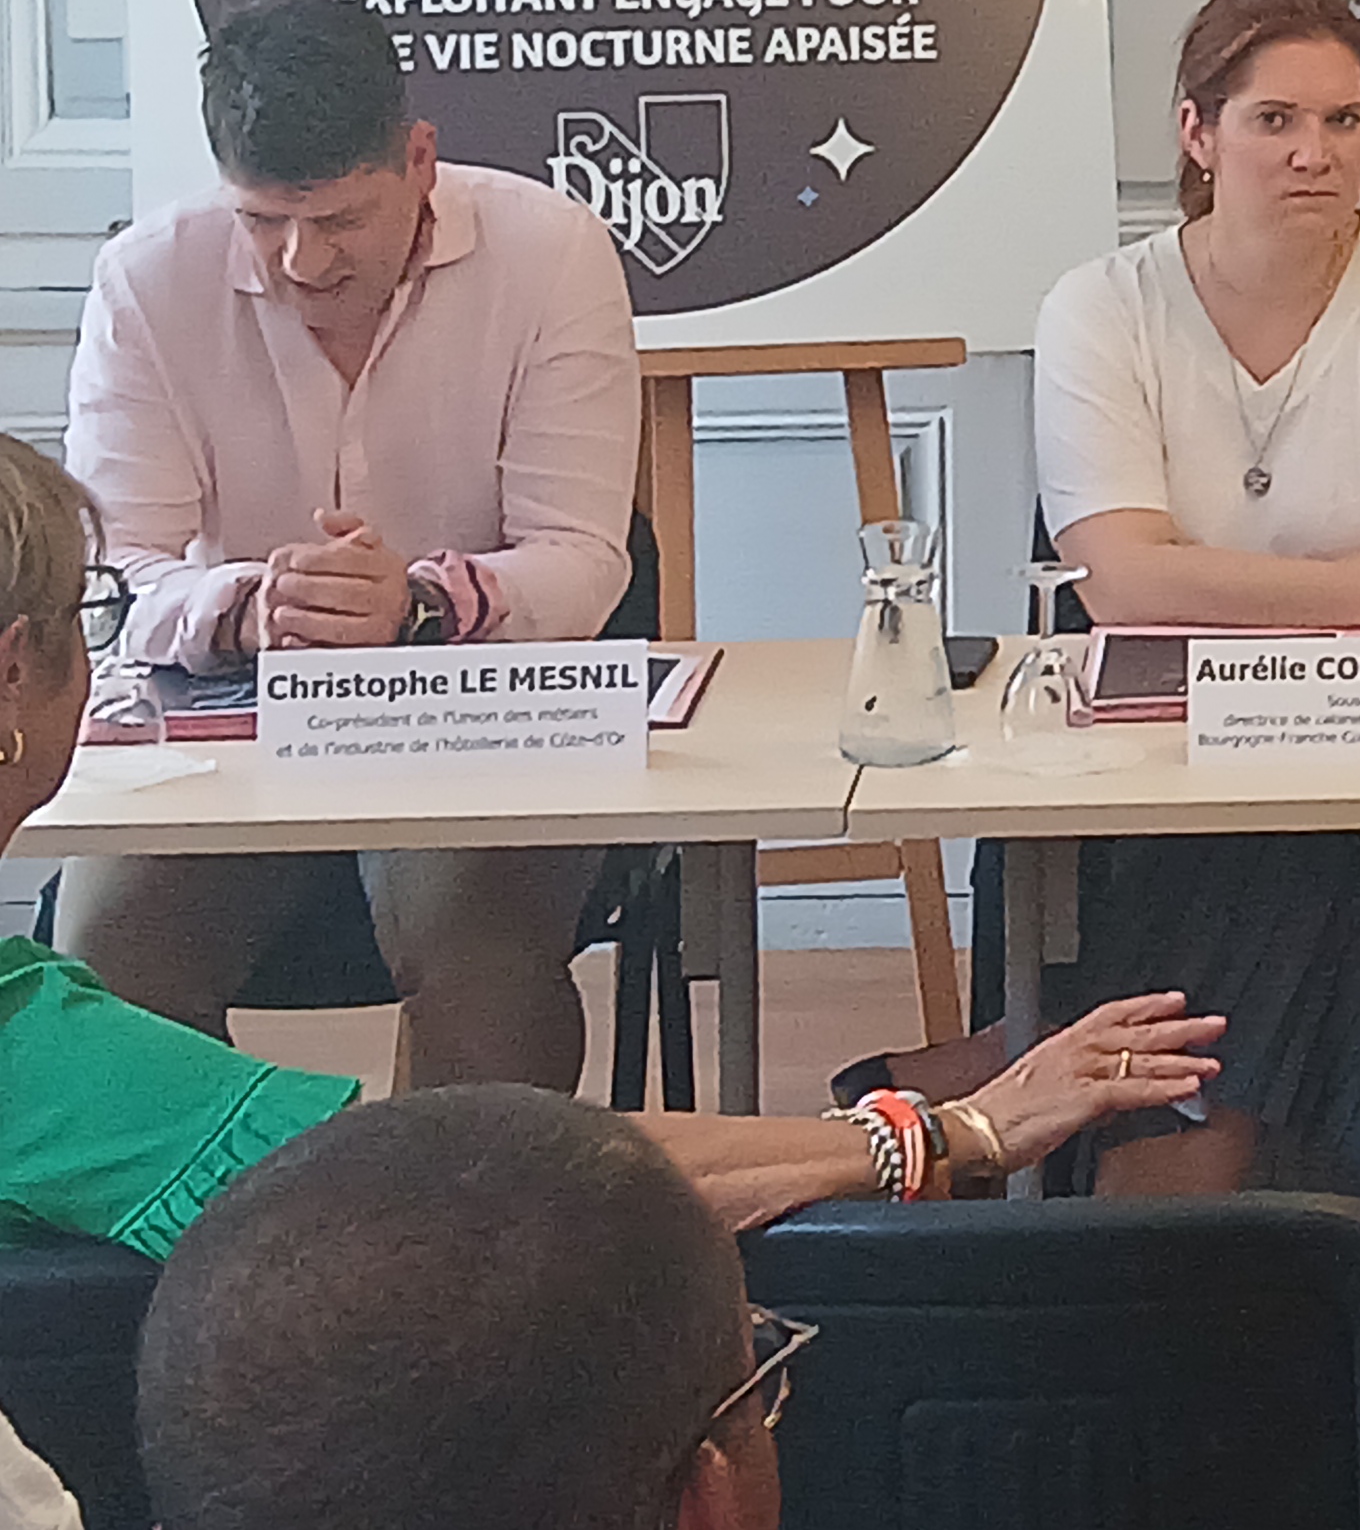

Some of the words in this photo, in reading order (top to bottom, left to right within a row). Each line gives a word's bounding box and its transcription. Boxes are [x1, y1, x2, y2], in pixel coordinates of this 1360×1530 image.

[424, 33, 499, 70] VIE
[512, 27, 752, 68] NOCTURNE
[763, 13, 938, 64] APAISÉE
[547, 152, 724, 250] Dijon
[267, 670, 448, 702] Christophe
[460, 669, 497, 693] LE
[509, 664, 639, 692] MESNIL
[1196, 655, 1306, 682] Aurélie
